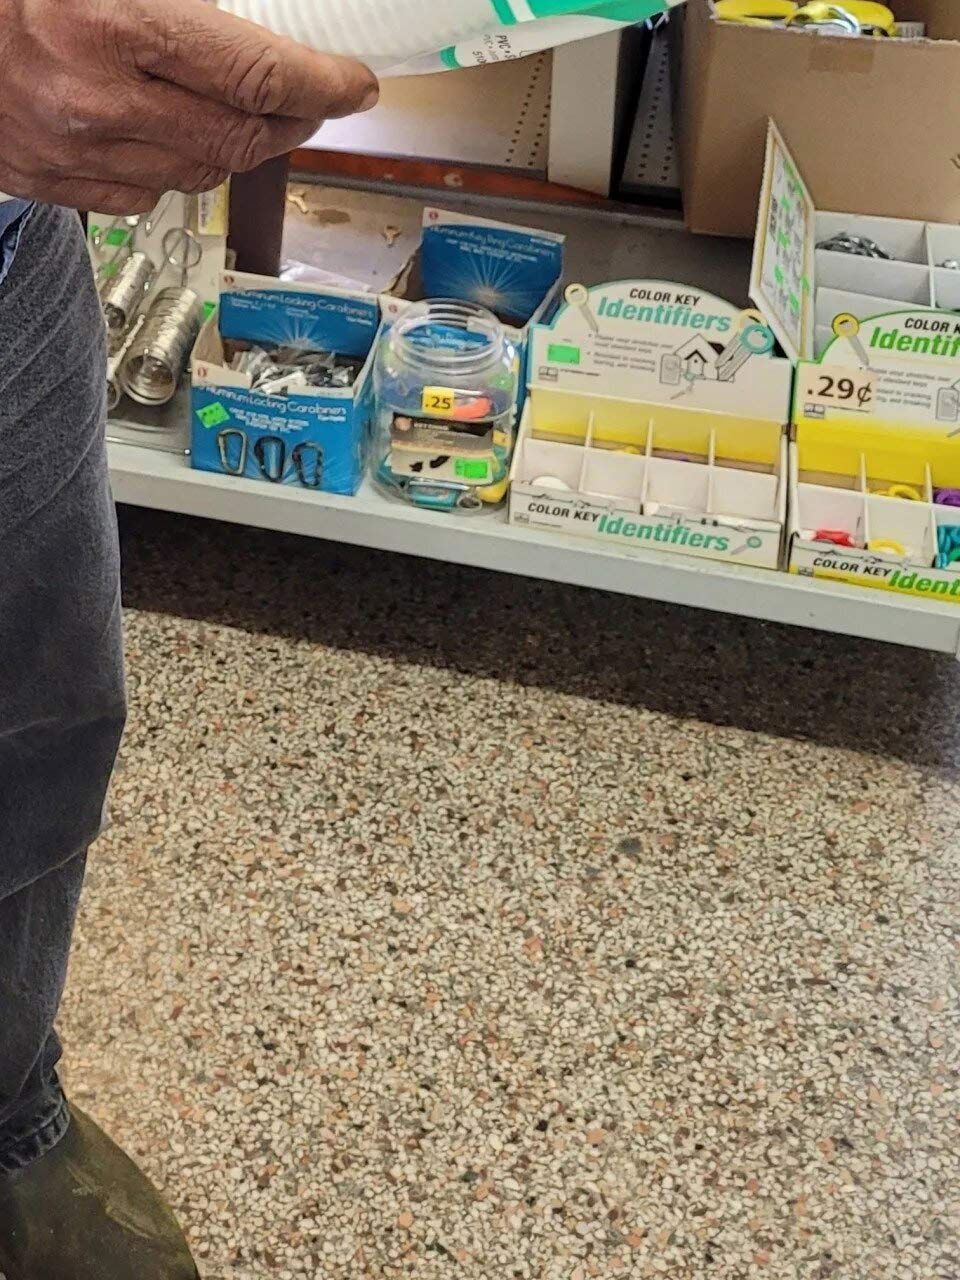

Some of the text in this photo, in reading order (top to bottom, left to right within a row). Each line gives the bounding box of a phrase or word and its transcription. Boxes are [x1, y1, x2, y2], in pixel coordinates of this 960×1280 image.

[495, 34, 512, 50] PVC
[629, 288, 701, 306] COLOR KEY
[597, 296, 731, 332] Identifiers
[904, 317, 950, 333] COLOR
[807, 375, 873, 408] .29¢
[425, 396, 451, 410] .25
[528, 502, 600, 523] COLOR KEY
[597, 514, 730, 552] Identifiers
[813, 557, 893, 577] COLOR KEY
